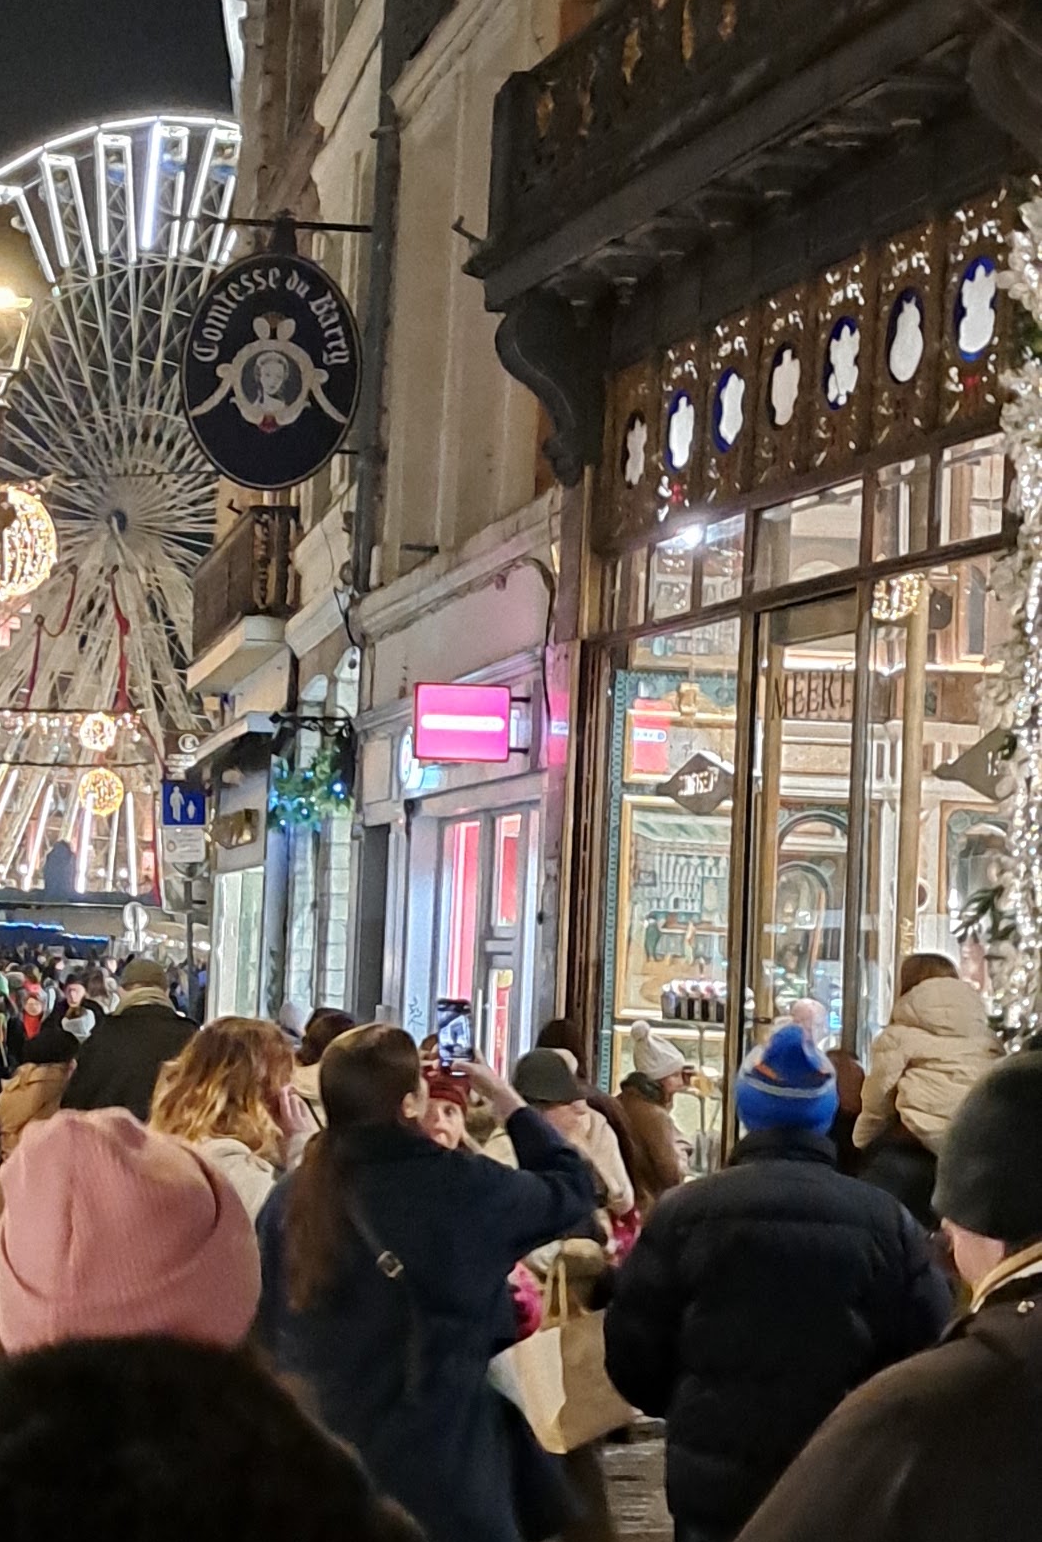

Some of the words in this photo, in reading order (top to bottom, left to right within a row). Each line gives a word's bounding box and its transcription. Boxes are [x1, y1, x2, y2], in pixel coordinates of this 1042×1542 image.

[193, 267, 281, 362] Comtesse
[285, 269, 310, 298] du
[309, 289, 350, 365] Barry
